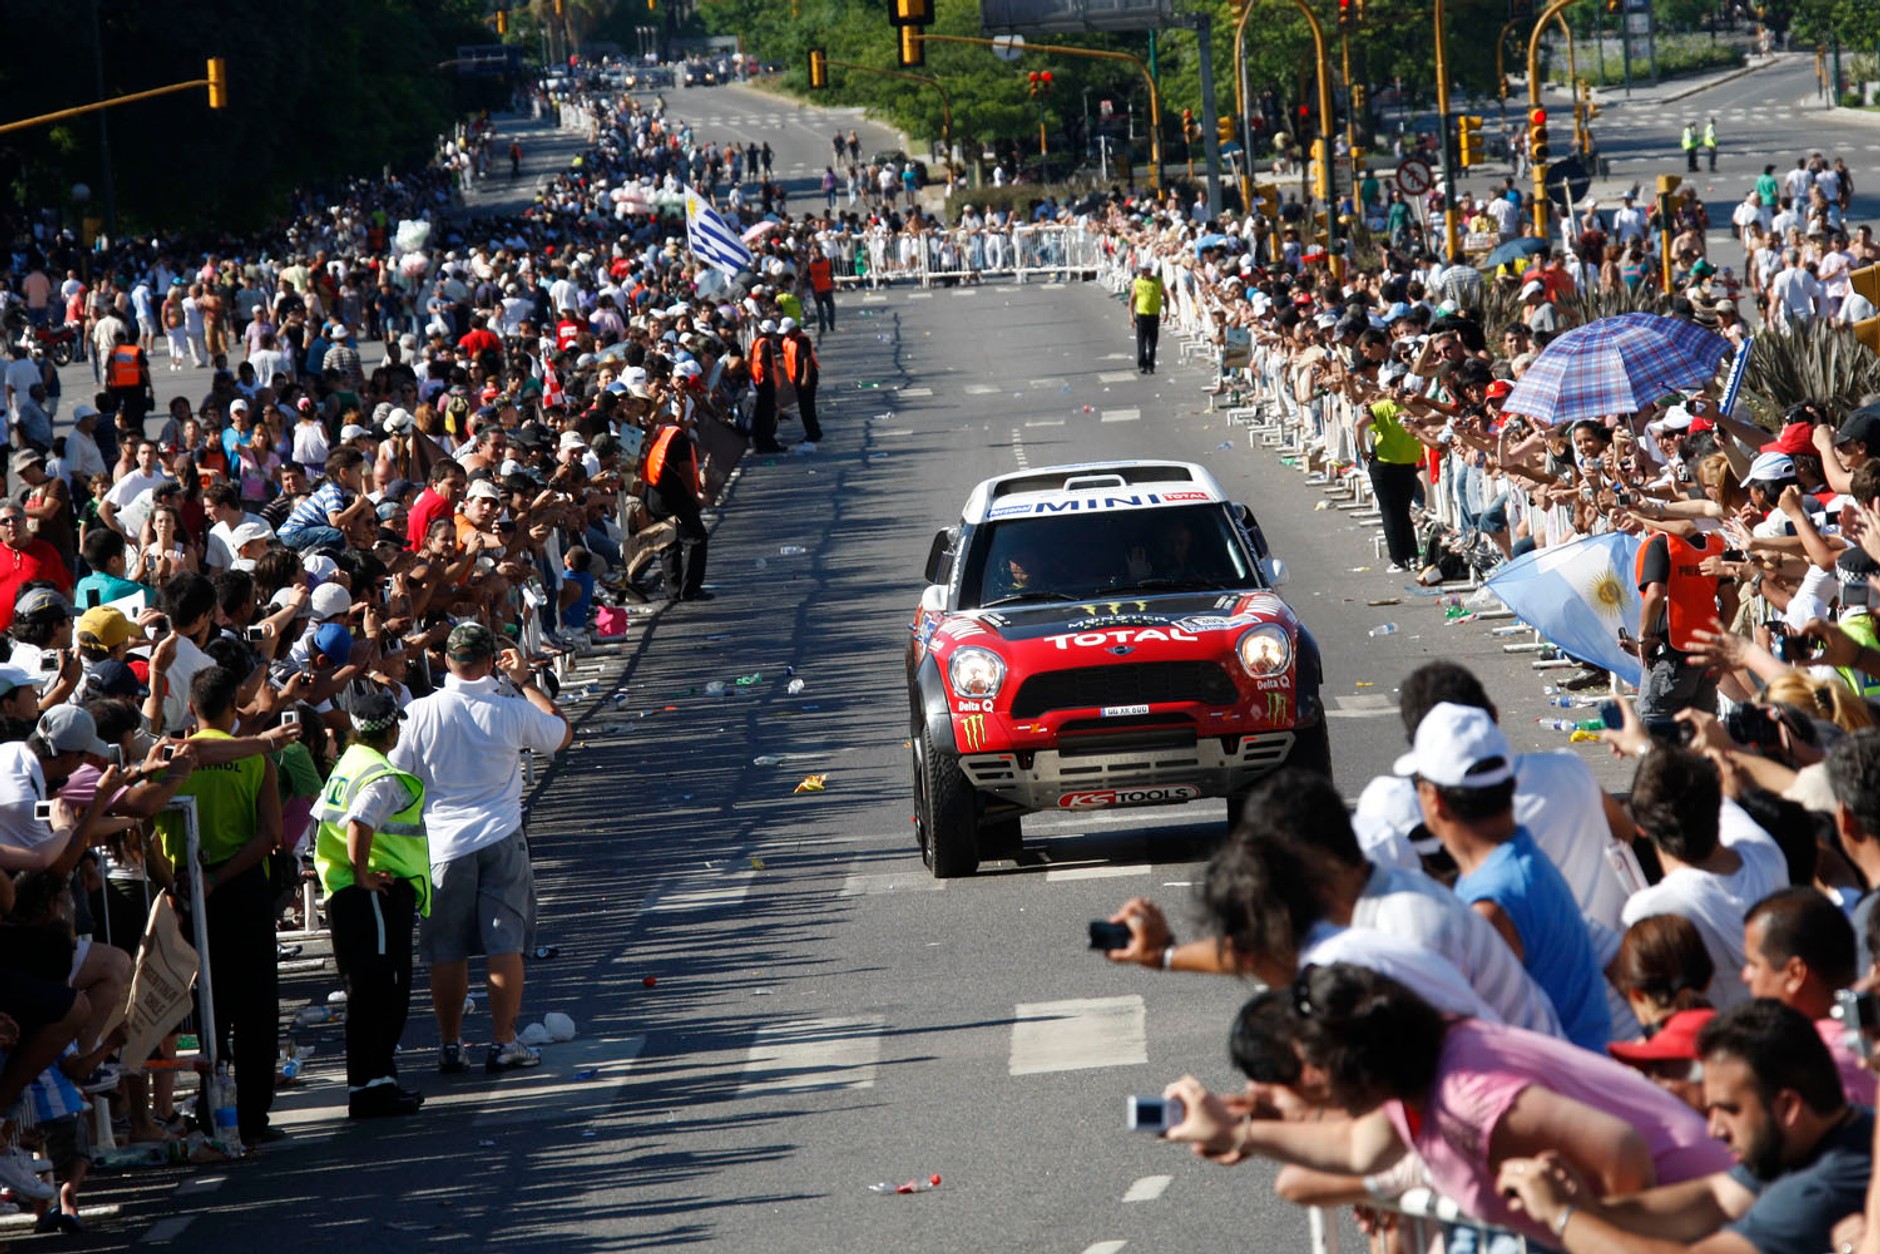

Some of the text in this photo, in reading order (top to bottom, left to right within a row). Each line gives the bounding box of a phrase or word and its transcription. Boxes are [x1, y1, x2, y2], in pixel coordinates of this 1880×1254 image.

[1035, 493, 1161, 513] MINI
[1164, 492, 1209, 501] TOTAL
[1068, 615, 1168, 629] MONSTER
[1044, 628, 1198, 650] TOTAL
[1257, 675, 1291, 690] Delta Q
[958, 699, 994, 713] Delta Q
[1069, 788, 1188, 808] KS TOOLS
